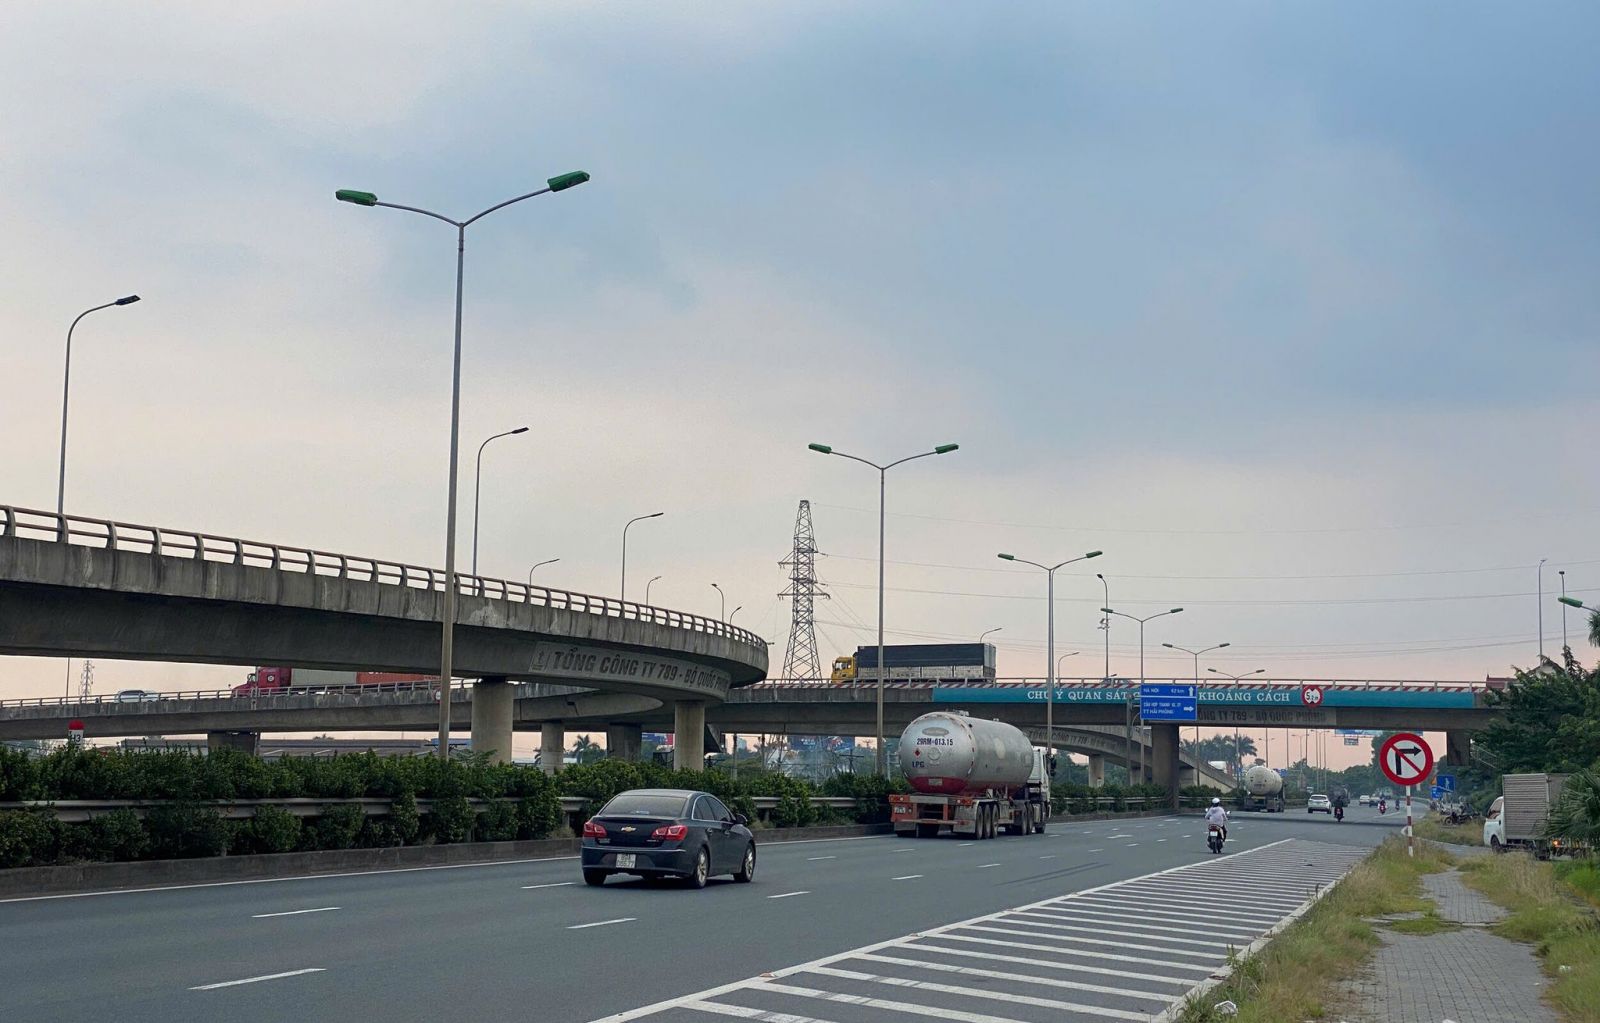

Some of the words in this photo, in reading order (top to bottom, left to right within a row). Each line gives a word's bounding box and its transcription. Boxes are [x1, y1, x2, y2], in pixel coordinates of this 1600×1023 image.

[553, 647, 596, 672] TỔNG
[600, 654, 639, 676] CÔNG
[641, 662, 656, 677] TY
[657, 664, 678, 680] 789
[1068, 691, 1102, 700] QUAN
[1106, 689, 1128, 700] SÁT
[1199, 689, 1251, 701] KHOẢNG
[1256, 690, 1290, 701] CÁCH
[1198, 710, 1216, 721] ÔNG
[1231, 711, 1247, 721] 789
